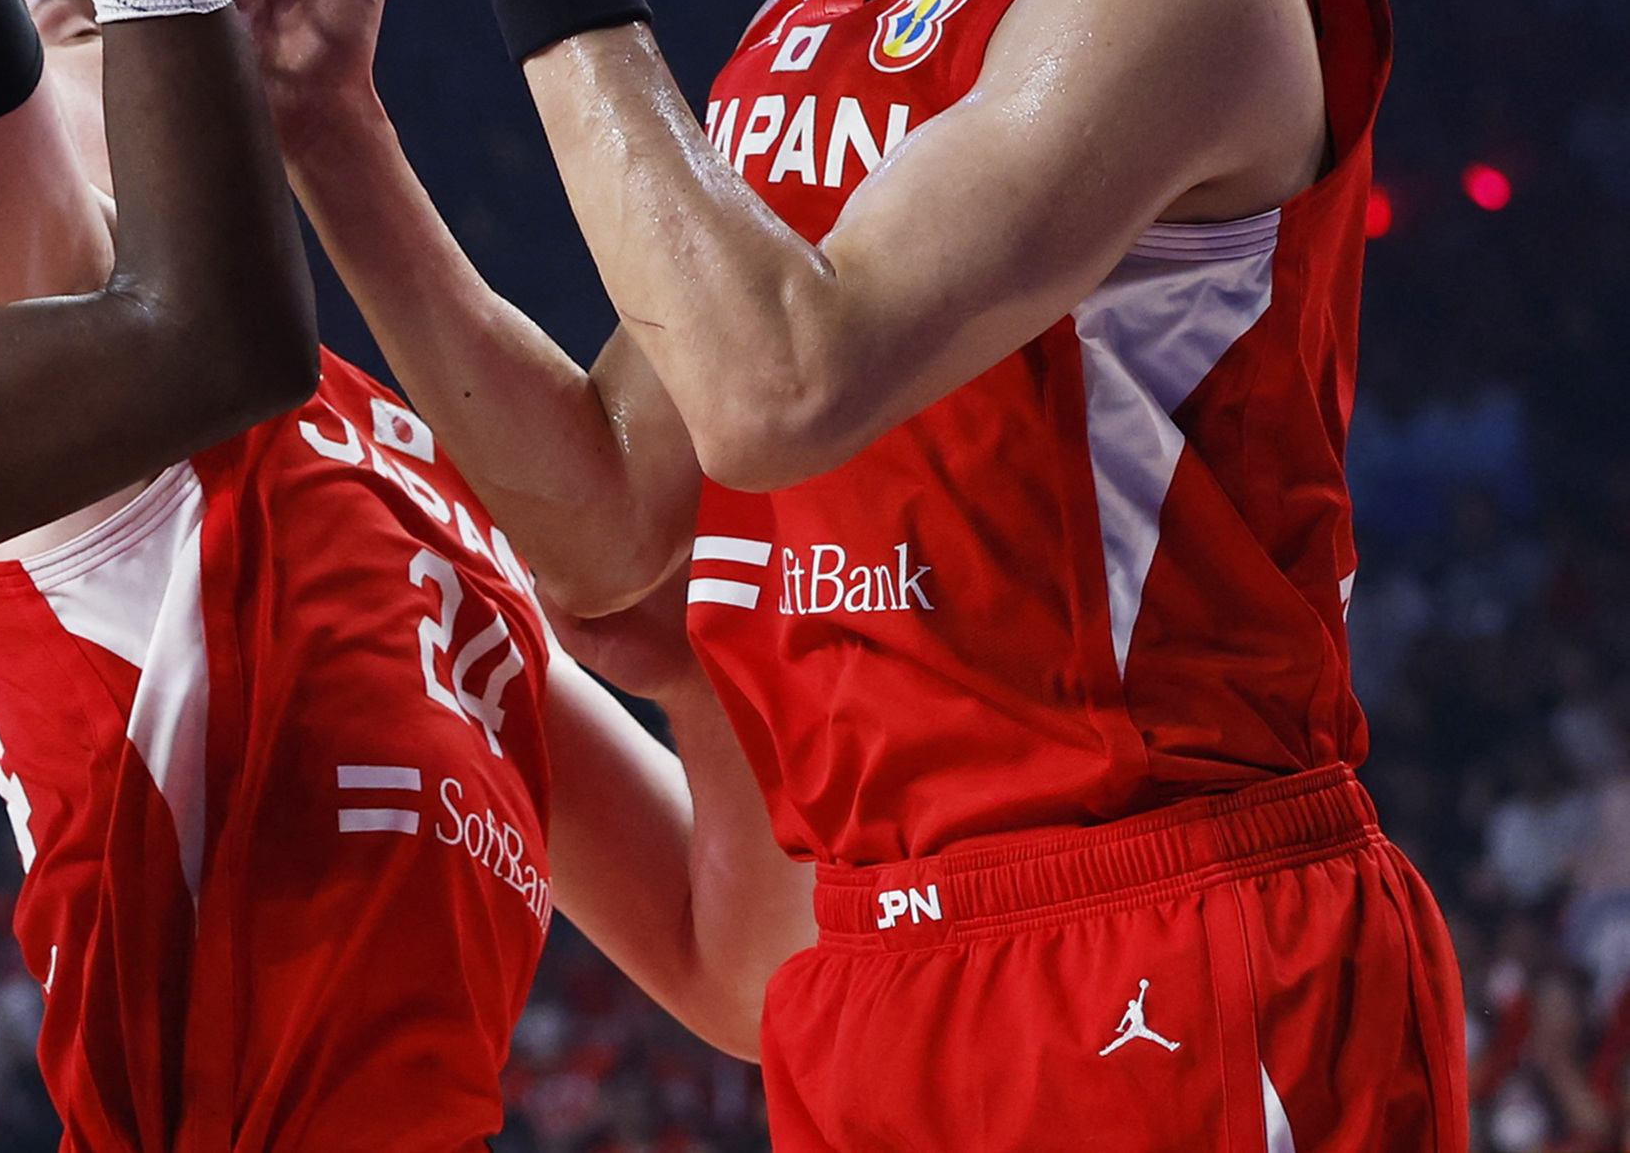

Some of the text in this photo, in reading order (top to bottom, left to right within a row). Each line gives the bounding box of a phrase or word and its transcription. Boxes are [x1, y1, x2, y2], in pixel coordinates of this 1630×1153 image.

[779, 542, 935, 615] ftBank
[408, 547, 525, 760] 24
[435, 777, 553, 935] SoftBan
[876, 883, 943, 930] JPN
